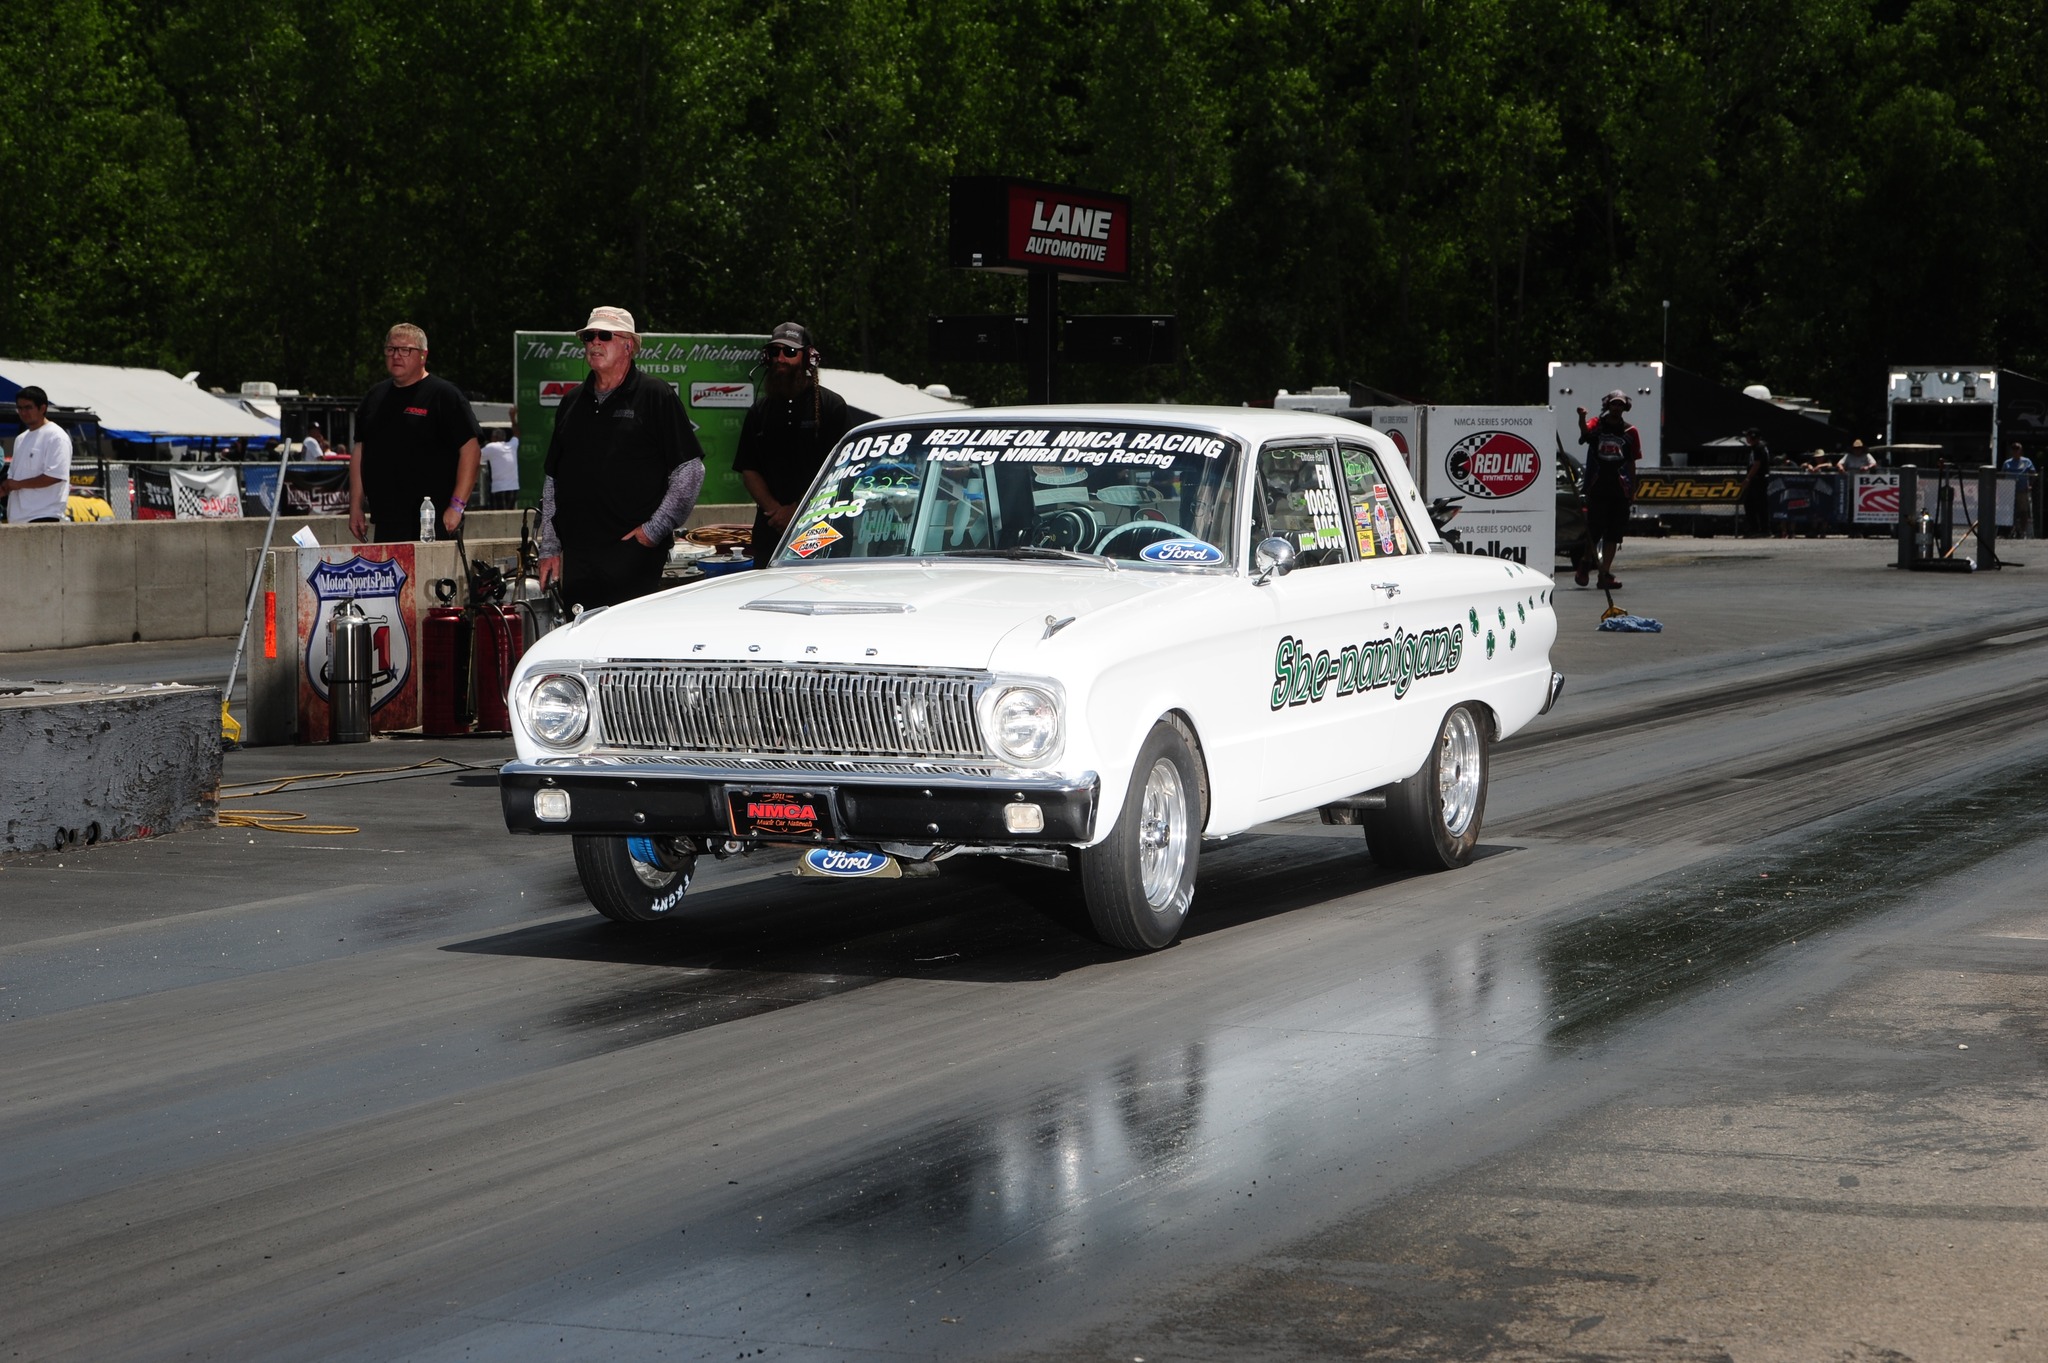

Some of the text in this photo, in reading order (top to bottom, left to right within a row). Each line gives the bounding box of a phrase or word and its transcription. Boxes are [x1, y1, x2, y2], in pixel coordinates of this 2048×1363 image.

[1031, 200, 1112, 241] LANE
[1025, 236, 1107, 262] AUTOMOTIVE
[523, 341, 554, 361] The
[555, 341, 586, 361] Fas
[665, 343, 684, 361] In
[685, 344, 761, 366] Michigan
[672, 364, 687, 374] BY
[1454, 418, 1533, 426] NMCA SERIES SPONSOR
[835, 433, 912, 467] 8058
[922, 429, 1225, 459] RED LINE OIL NMCA RACING
[926, 448, 1176, 470] Holley NMRA Drag Racing
[1474, 453, 1534, 474] RED LINE
[851, 475, 914, 493] 1325
[1315, 464, 1335, 489] FM
[1859, 476, 1898, 486] BAE
[1637, 479, 1744, 498] Haltech
[1304, 488, 1340, 515] 10058
[1477, 526, 1498, 534] SERIES
[1499, 525, 1532, 534] SPONSOR
[799, 541, 820, 551] CAMS
[1158, 543, 1208, 560] Ford
[320, 571, 395, 594] MotorSportsPark
[692, 643, 877, 656] FORD
[1270, 624, 1463, 711] She-nanigans
[747, 802, 818, 821] NMCA
[823, 849, 872, 870] Ford
